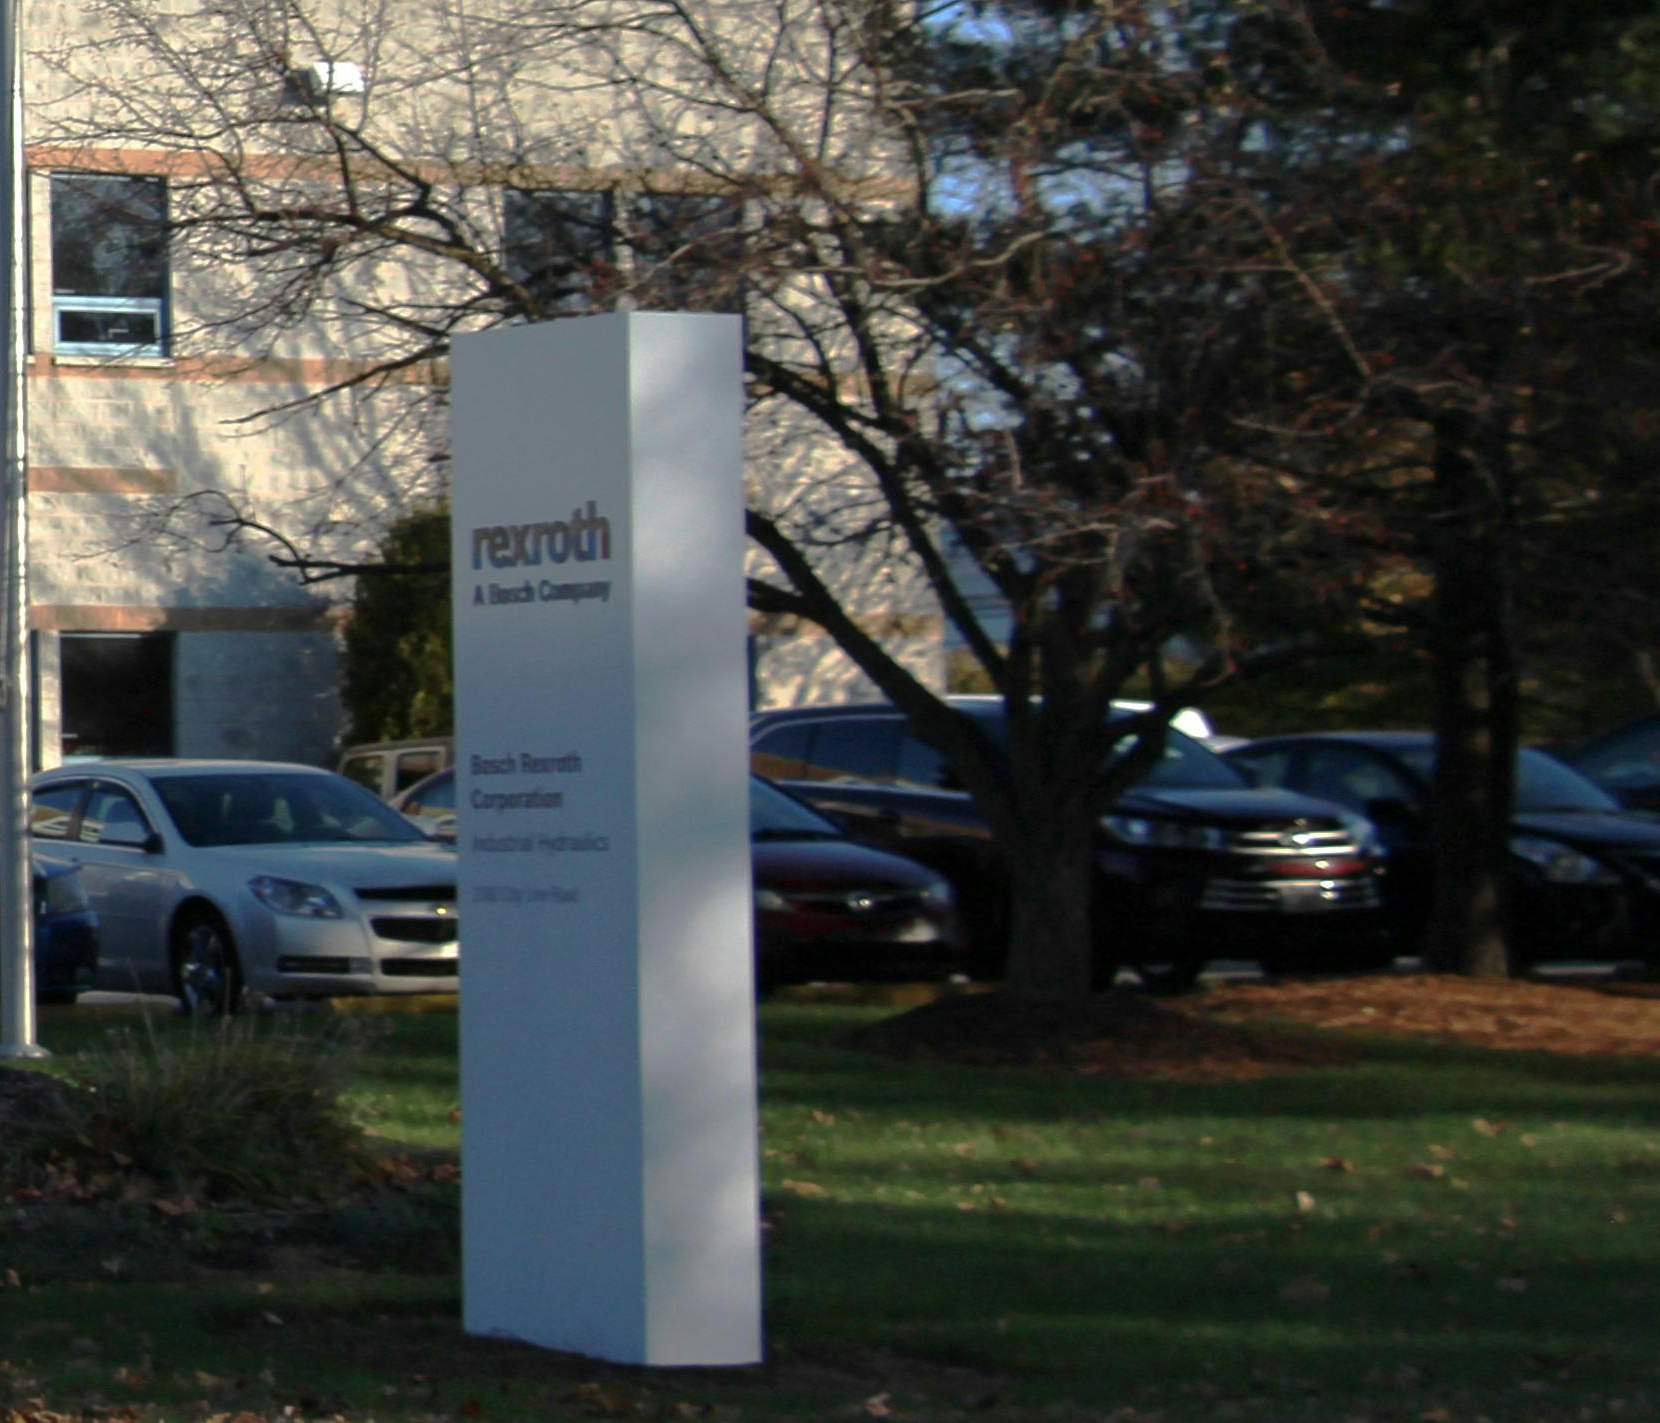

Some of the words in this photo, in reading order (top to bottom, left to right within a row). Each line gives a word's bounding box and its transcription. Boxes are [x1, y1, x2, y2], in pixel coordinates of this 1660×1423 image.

[472, 500, 611, 570] rexroth
[473, 584, 486, 606] A
[538, 579, 612, 605] Company
